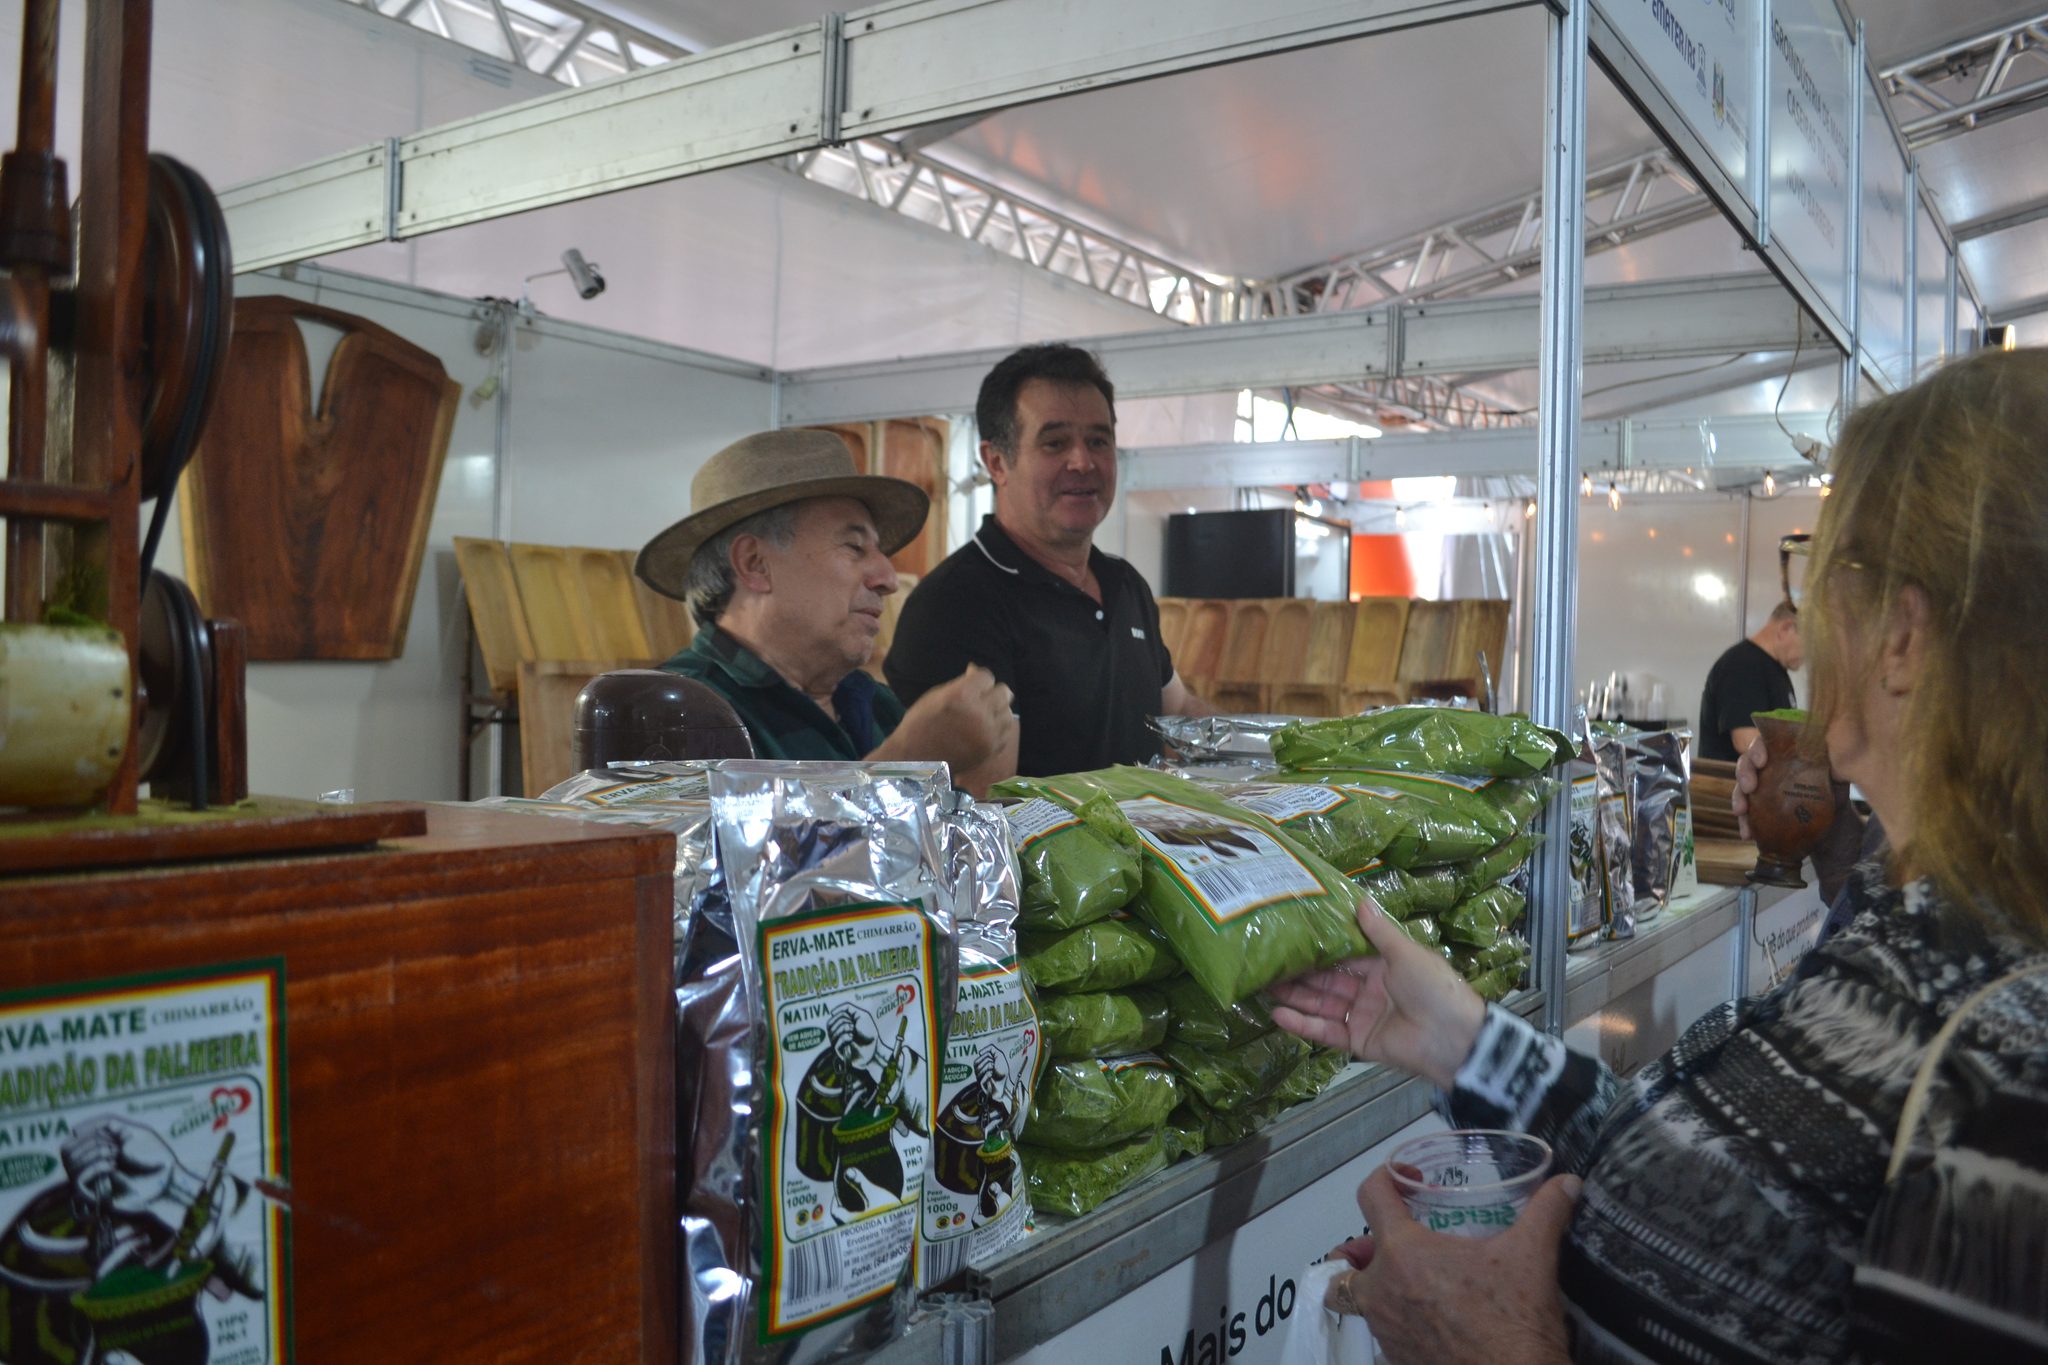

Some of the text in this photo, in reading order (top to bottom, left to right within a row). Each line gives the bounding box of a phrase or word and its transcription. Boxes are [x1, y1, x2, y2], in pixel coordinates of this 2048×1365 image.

[772, 922, 917, 961] ERVA-MATE CHIMARRÃO
[774, 945, 920, 1001] TRADIÇÃO DA PALMEIRA
[152, 998, 255, 1026] CHIMARRÃO
[783, 1003, 830, 1025] NATIVA
[989, 1004, 1003, 1031] DA
[105, 1050, 140, 1090] DA
[144, 1030, 262, 1080] PALMEIRA
[903, 1145, 922, 1157] TIPO
[787, 1193, 818, 1209] 1000g
[927, 1202, 958, 1214] 1000g
[1255, 1273, 1296, 1336] do
